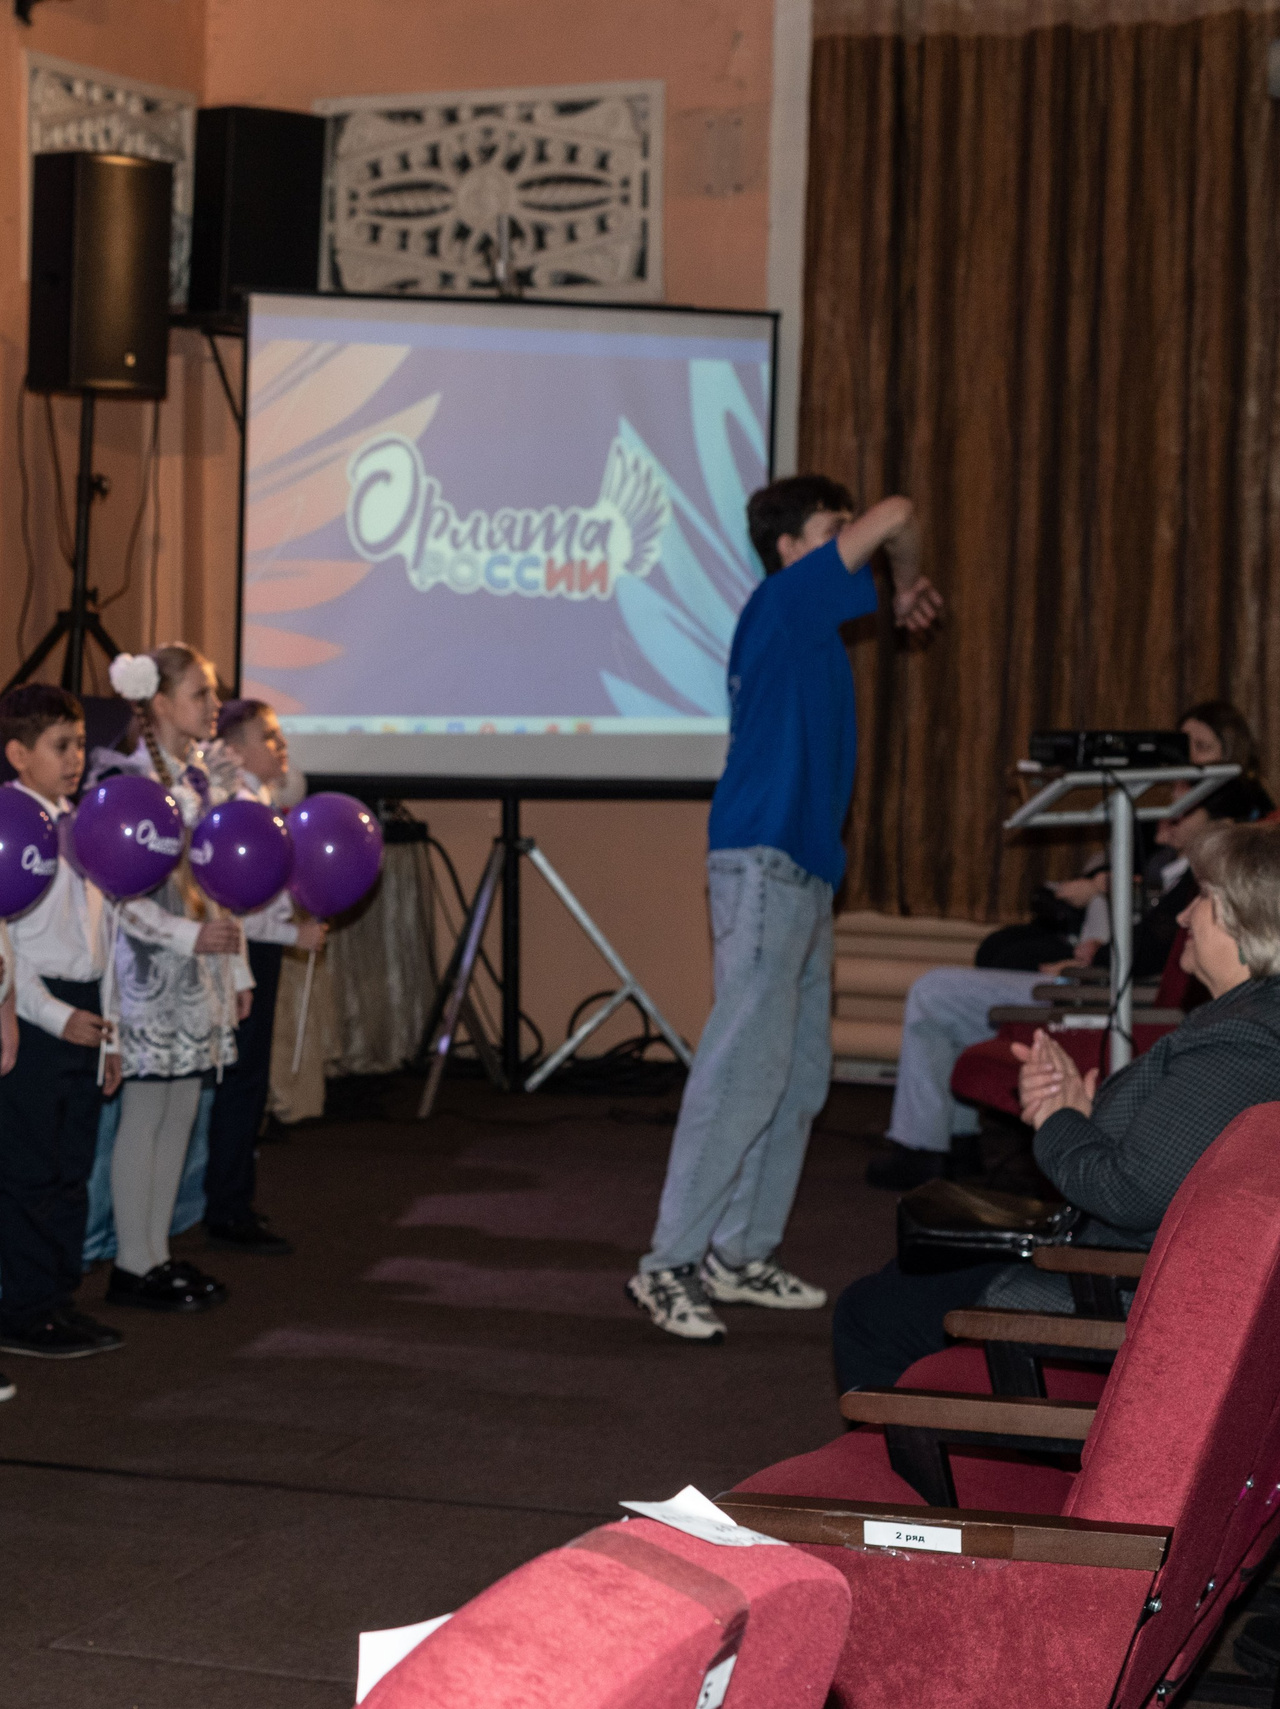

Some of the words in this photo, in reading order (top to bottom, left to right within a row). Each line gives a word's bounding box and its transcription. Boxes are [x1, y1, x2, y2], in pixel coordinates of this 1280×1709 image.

[349, 436, 614, 571] Орлята
[422, 553, 610, 595] РОССИИ
[895, 1531, 902, 1540] 2
[905, 1534, 926, 1543] ряд
